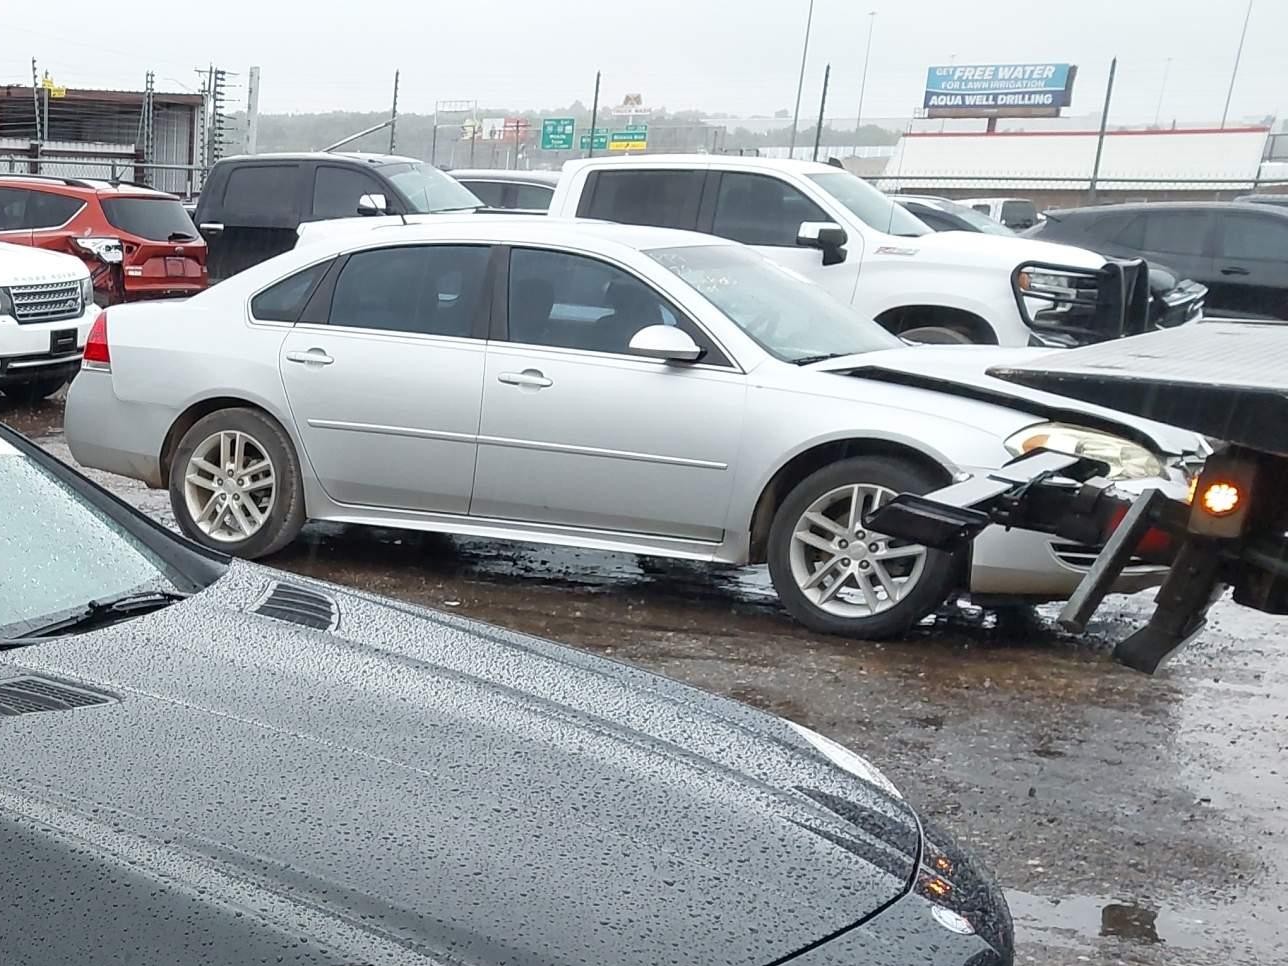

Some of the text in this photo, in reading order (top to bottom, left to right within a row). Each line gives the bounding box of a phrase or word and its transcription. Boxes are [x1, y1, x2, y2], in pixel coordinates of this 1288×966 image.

[936, 65, 1056, 80] GET FREE WATER
[941, 79, 1045, 89] FOR LAWN IRRIGATION
[929, 93, 1053, 106] AQUA WELL DRILLING
